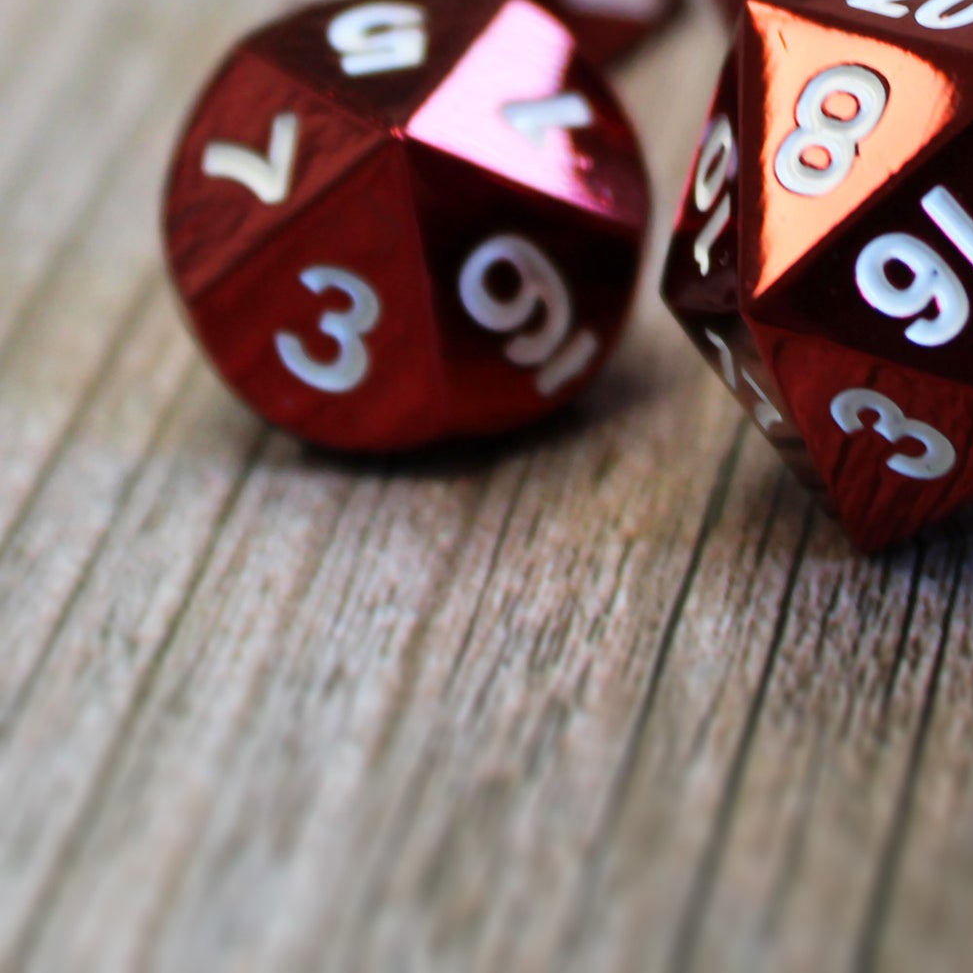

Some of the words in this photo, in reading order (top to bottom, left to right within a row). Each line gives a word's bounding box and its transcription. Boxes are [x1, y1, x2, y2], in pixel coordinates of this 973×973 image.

[326, 0, 428, 77] 5
[202, 112, 298, 206] 7
[773, 63, 891, 197] 8
[274, 265, 382, 394] 3
[829, 387, 956, 481] 3
